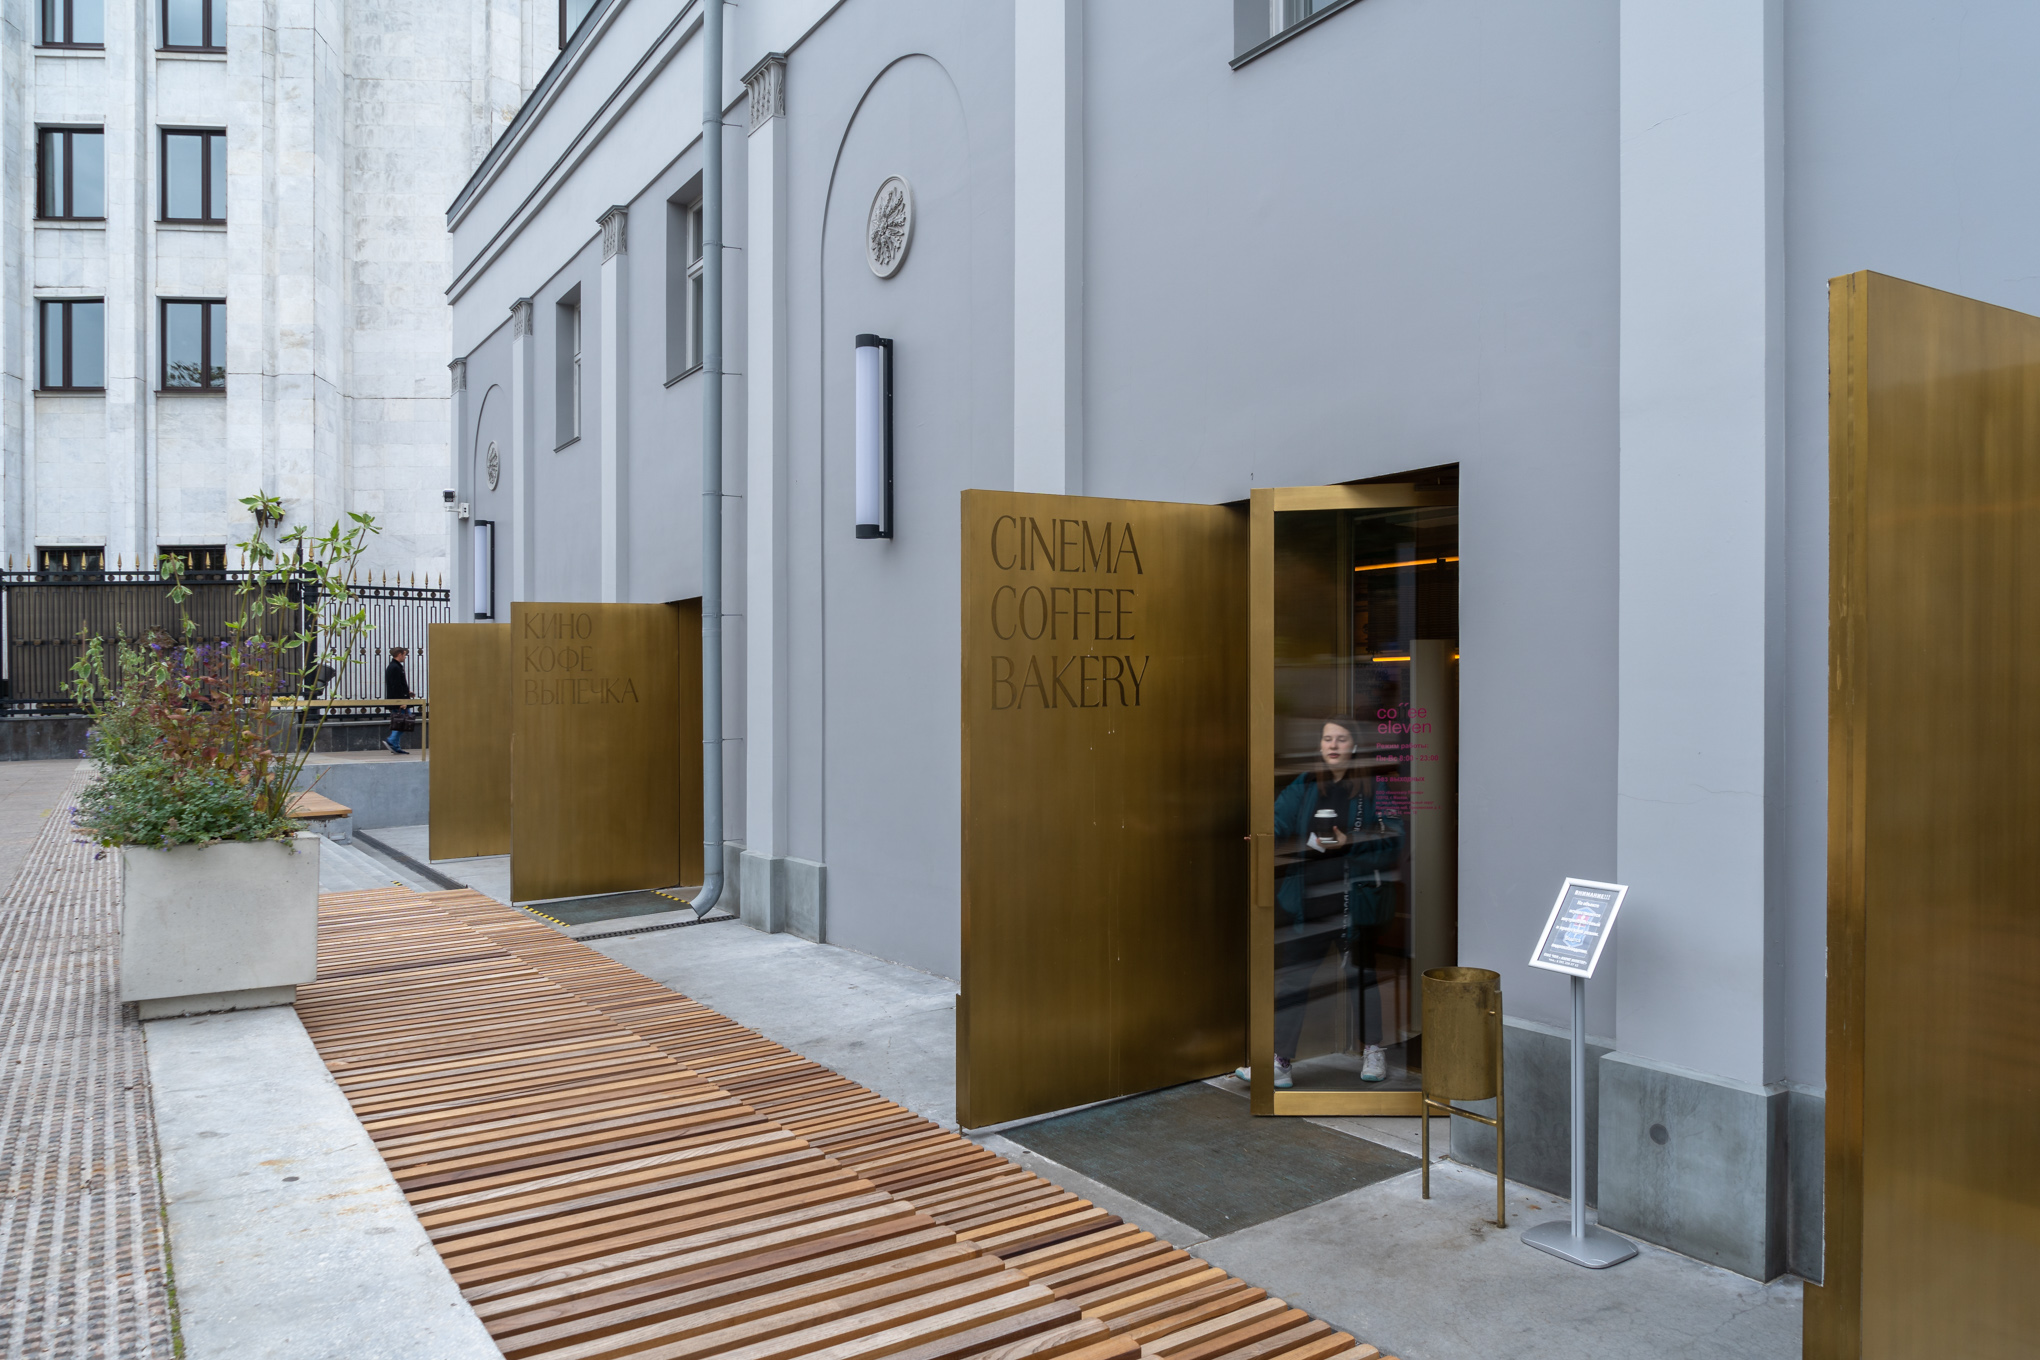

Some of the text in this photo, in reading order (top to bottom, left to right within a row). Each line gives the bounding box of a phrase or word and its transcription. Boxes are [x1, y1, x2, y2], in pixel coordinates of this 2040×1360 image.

[990, 514, 1144, 575] CINEMA
[524, 612, 592, 640] КИНО
[990, 584, 1136, 641] COFFEE
[524, 645, 593, 673] КОФЕ
[524, 677, 639, 706] ВЫПЕЧКА
[990, 654, 1150, 711] BAKERY
[1377, 720, 1432, 734] eleven
